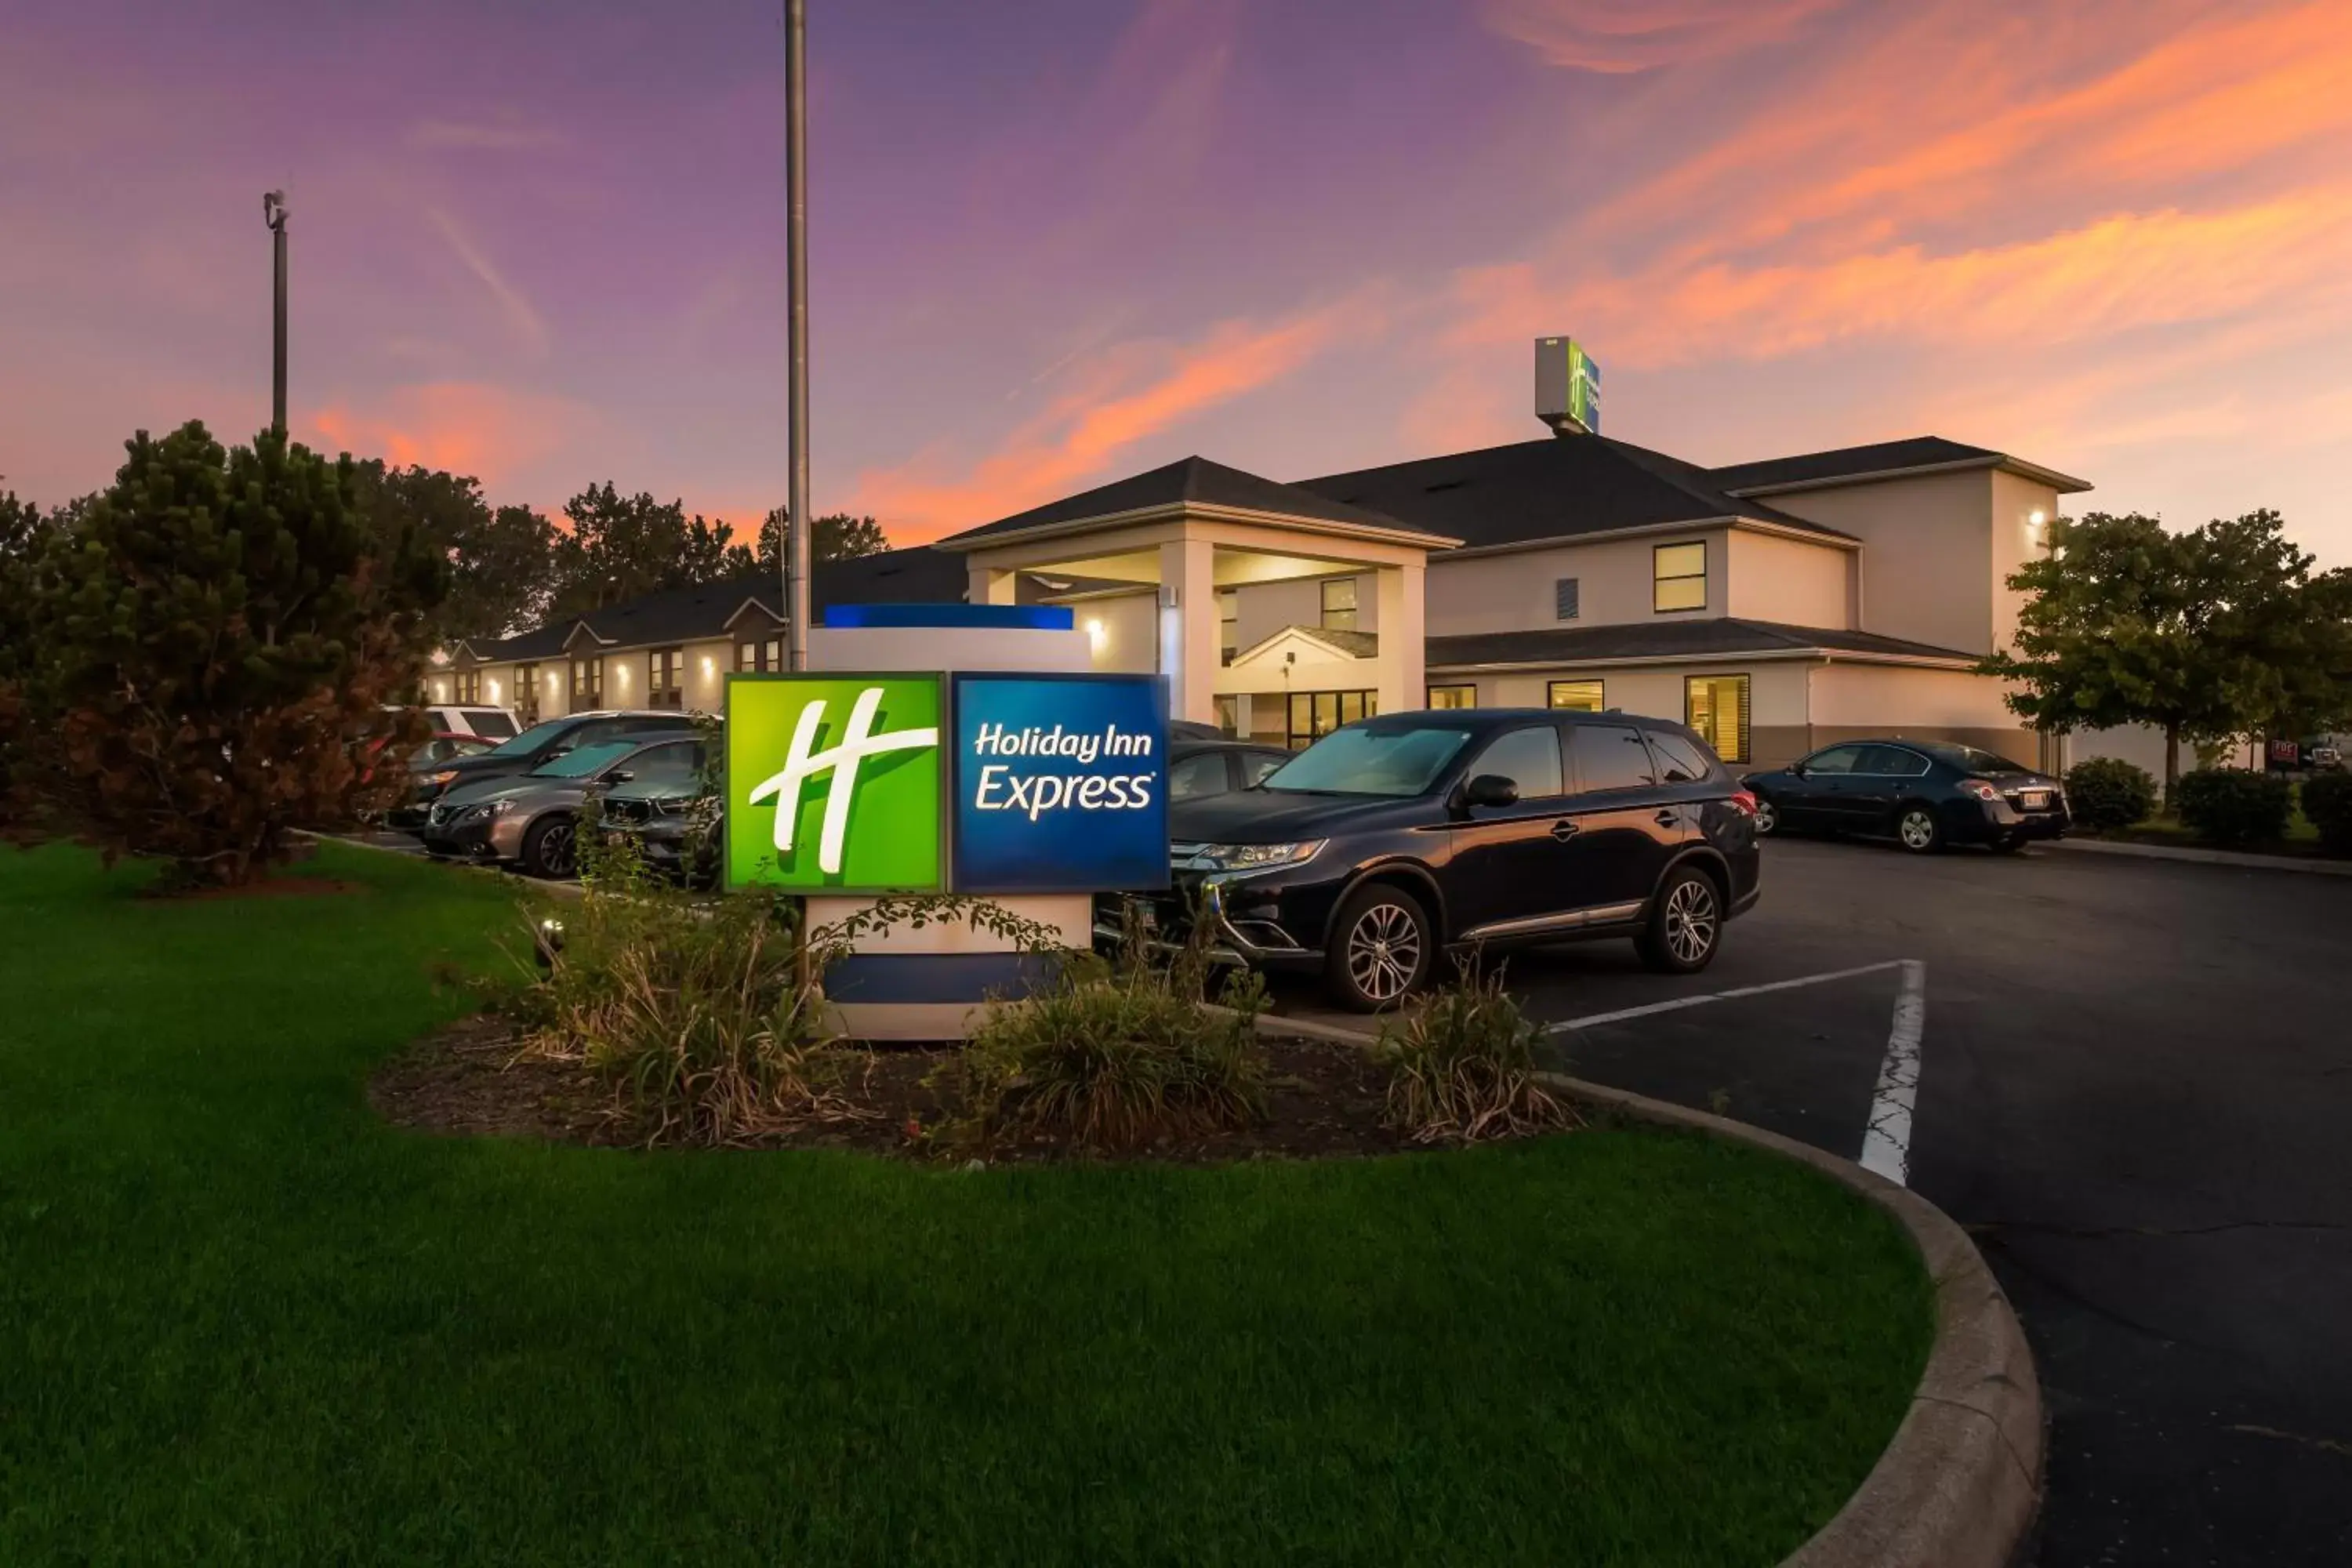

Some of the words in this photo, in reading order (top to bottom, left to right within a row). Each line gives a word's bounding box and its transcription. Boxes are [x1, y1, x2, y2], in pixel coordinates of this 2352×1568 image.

[974, 722, 1101, 764] Holiday
[1103, 724, 1152, 757] Inn
[975, 764, 1152, 822] Express
